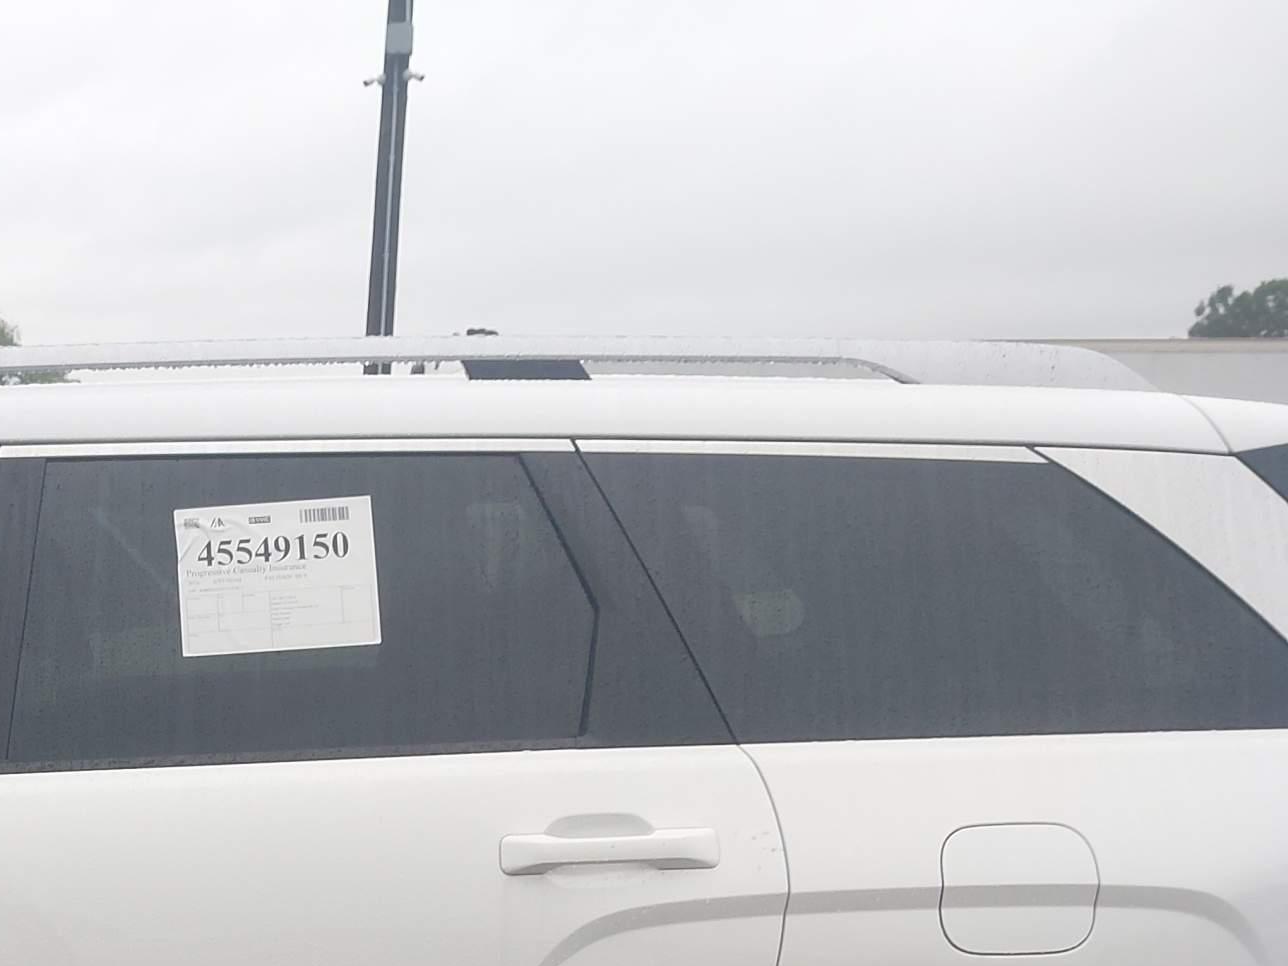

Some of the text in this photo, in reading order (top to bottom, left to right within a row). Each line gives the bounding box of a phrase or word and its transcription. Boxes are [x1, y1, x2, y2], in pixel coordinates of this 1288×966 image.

[197, 531, 349, 567] 45549150
[186, 564, 307, 578] Progressive Casualty Insurance
